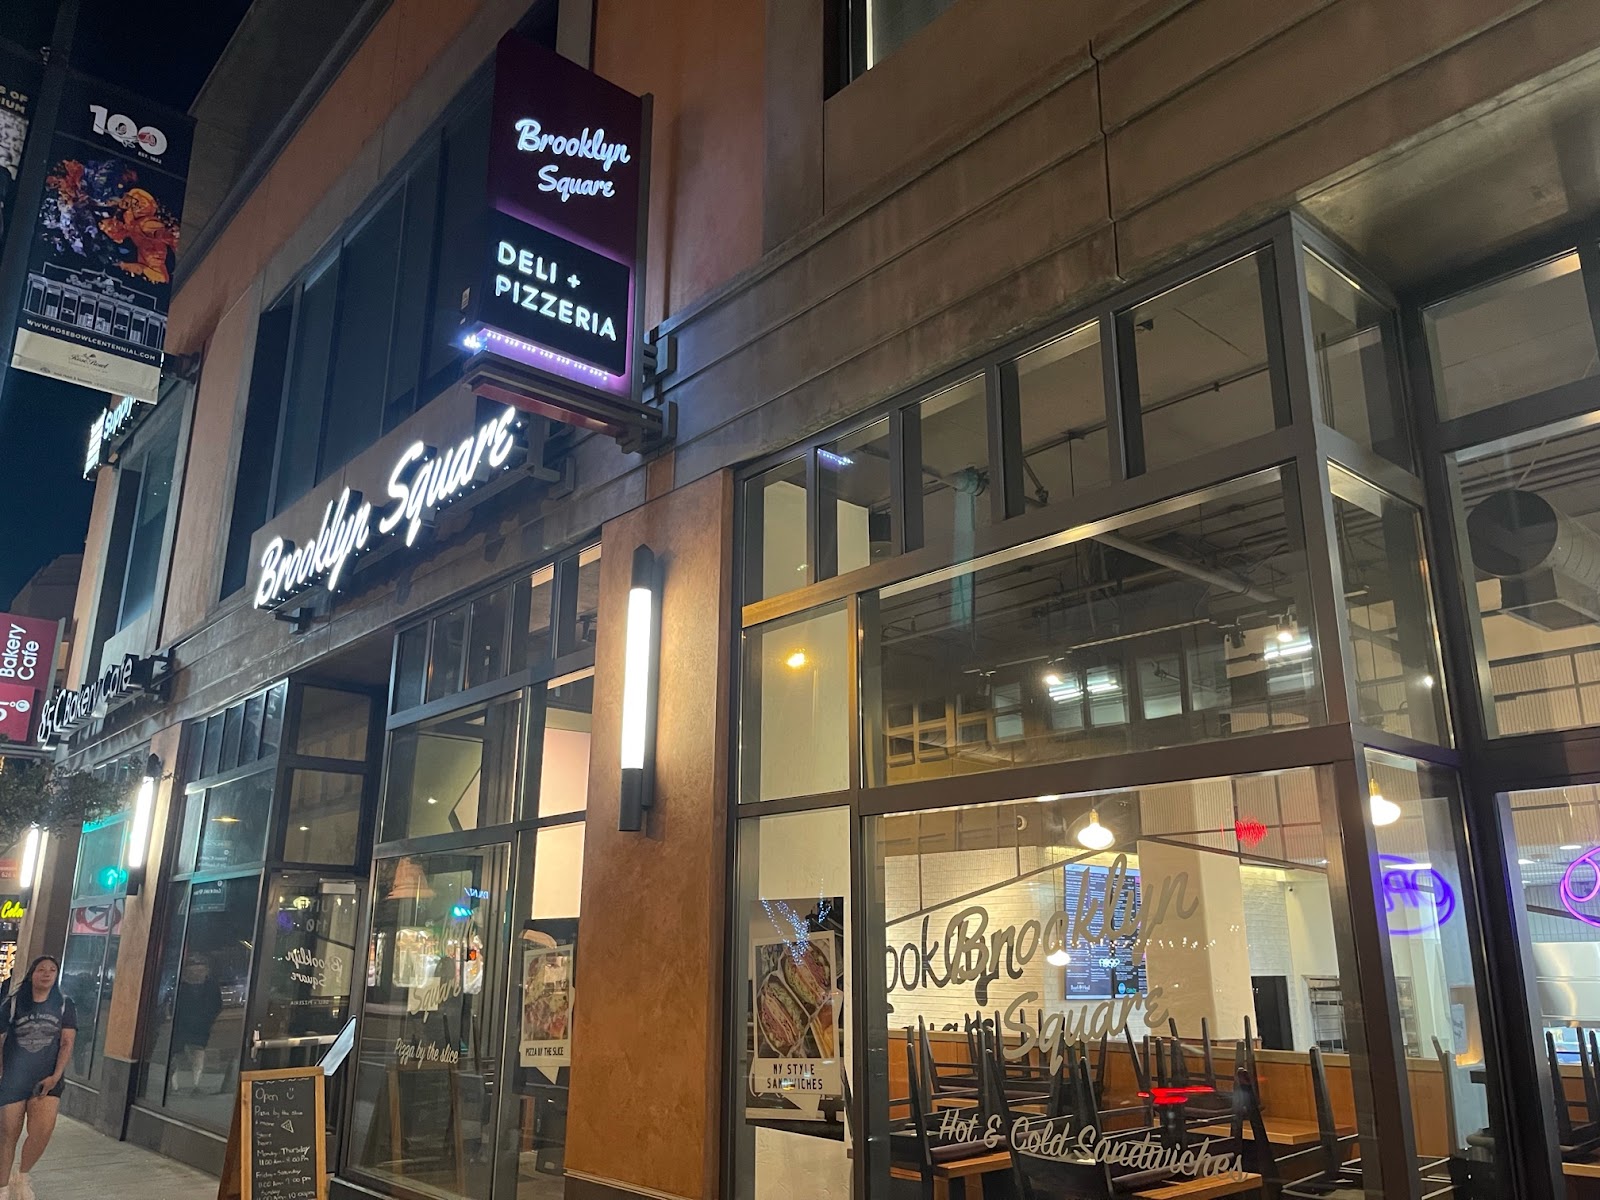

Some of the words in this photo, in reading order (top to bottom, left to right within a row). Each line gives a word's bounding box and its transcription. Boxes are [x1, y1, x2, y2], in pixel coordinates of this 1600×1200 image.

[10, 91, 28, 102] OF
[90, 104, 168, 155] 100
[515, 118, 631, 172] Brooklyn
[537, 165, 615, 203] Square
[496, 240, 557, 285] DELI
[495, 274, 617, 342] PIZZERIA
[26, 319, 156, 361] WWW.ROSEBOWLCENTENNIAL.COM
[253, 486, 372, 610] Brooklyn
[379, 405, 516, 548] Square
[0, 623, 27, 678] Bakery
[17, 640, 39, 680] Cafe
[63, 681, 100, 727] Bakery
[947, 853, 1199, 979] Brooklyn
[525, 1047, 537, 1056] PIZZA
[544, 1047, 552, 1056] THE
[552, 1047, 564, 1056] SLICE
[1003, 986, 1170, 1076] Square
[395, 1038, 415, 1066] Pizza
[416, 1039, 426, 1069] by
[427, 1040, 439, 1063] the
[439, 1043, 458, 1064] slice
[773, 1063, 782, 1074] NY
[787, 1063, 815, 1075] STYLE
[255, 1088, 278, 1103] Open
[273, 1107, 280, 1118] by
[281, 1145, 310, 1155] Thursday
[938, 1109, 978, 1144] Hot
[1010, 1116, 1070, 1157] Cold
[1074, 1125, 1249, 1183] Sandwiches
